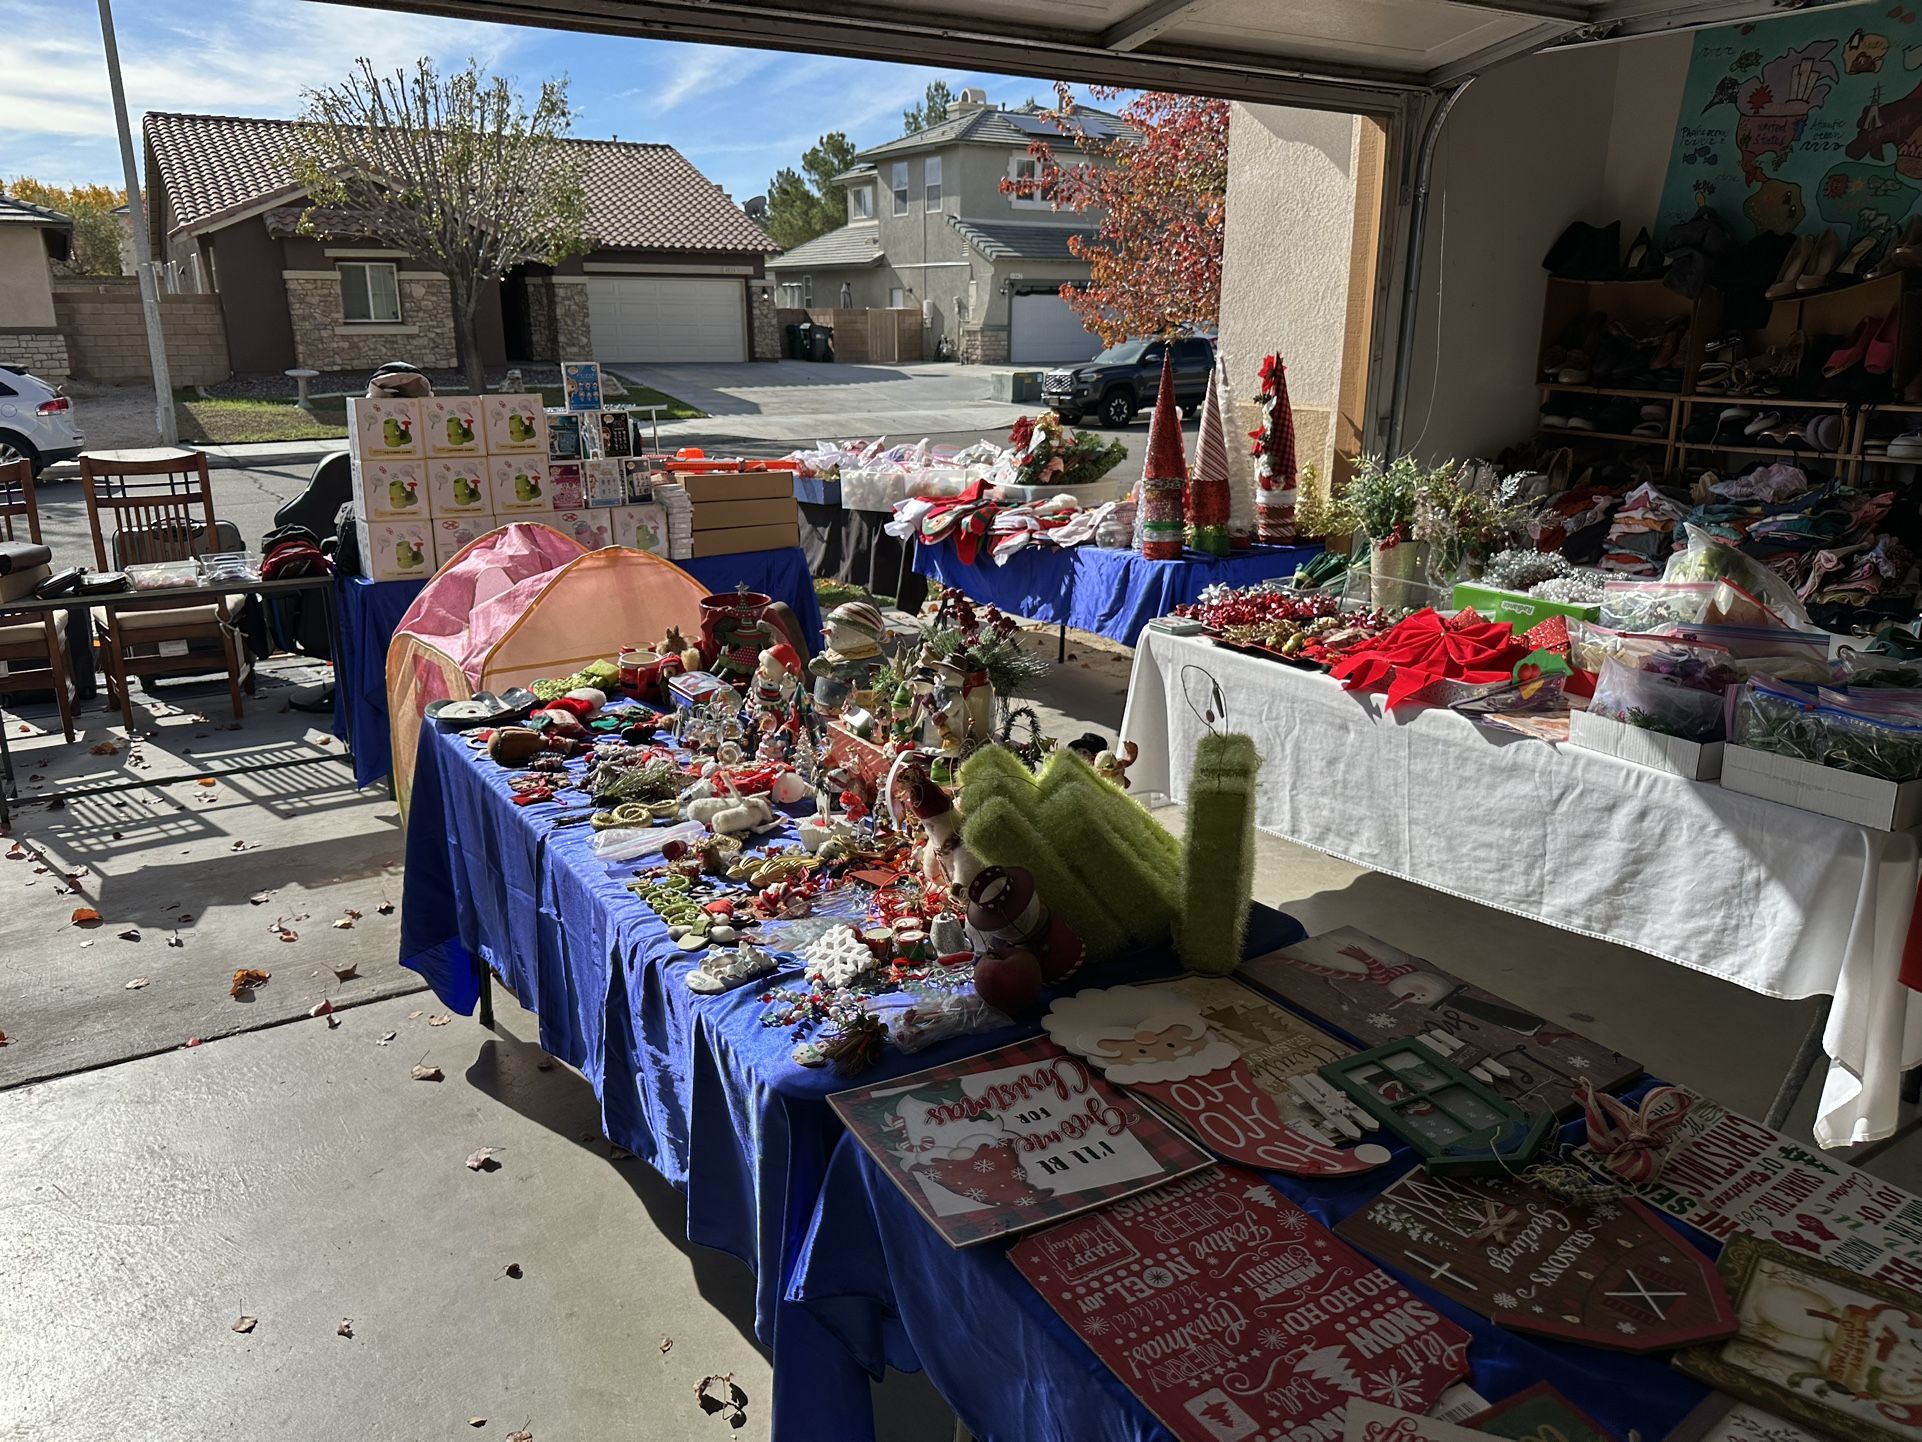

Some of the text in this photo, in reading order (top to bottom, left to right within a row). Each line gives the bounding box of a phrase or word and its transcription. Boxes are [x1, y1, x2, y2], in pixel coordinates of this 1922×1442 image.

[924, 1055, 1090, 1125] Christmas
[1170, 1070, 1251, 1112] HO
[1014, 1098, 1140, 1153] Gnome
[1016, 1107, 1052, 1124] FOR
[1199, 1097, 1280, 1148] HO
[1035, 1141, 1115, 1175] I'LL BE
[1257, 1130, 1344, 1171] HO
[1659, 1114, 1779, 1198] CHRISTMAS
[1756, 1157, 1785, 1176] OF
[1754, 1168, 1825, 1217] SHARE THE
[1825, 1172, 1873, 1204] Christmas
[1856, 1185, 1907, 1225] JOY OF
[1140, 1191, 1244, 1245] CHEER
[1188, 1209, 1273, 1261] Festive
[1485, 1202, 1571, 1274] Greetings
[1686, 1210, 1755, 1238] HE
[1734, 1205, 1774, 1228] Joy
[1063, 1240, 1121, 1271] HAPPY
[1529, 1228, 1597, 1289] SEASON'S
[1075, 1255, 1201, 1315] NOEL JOY
[1253, 1262, 1325, 1302] MERRY
[1277, 1268, 1399, 1336] HO HO HO!
[1127, 1300, 1250, 1379] Christmas!
[1345, 1299, 1441, 1360] SNOW
[1147, 1338, 1235, 1392] MERRY
[1263, 1376, 1330, 1416] Bells
